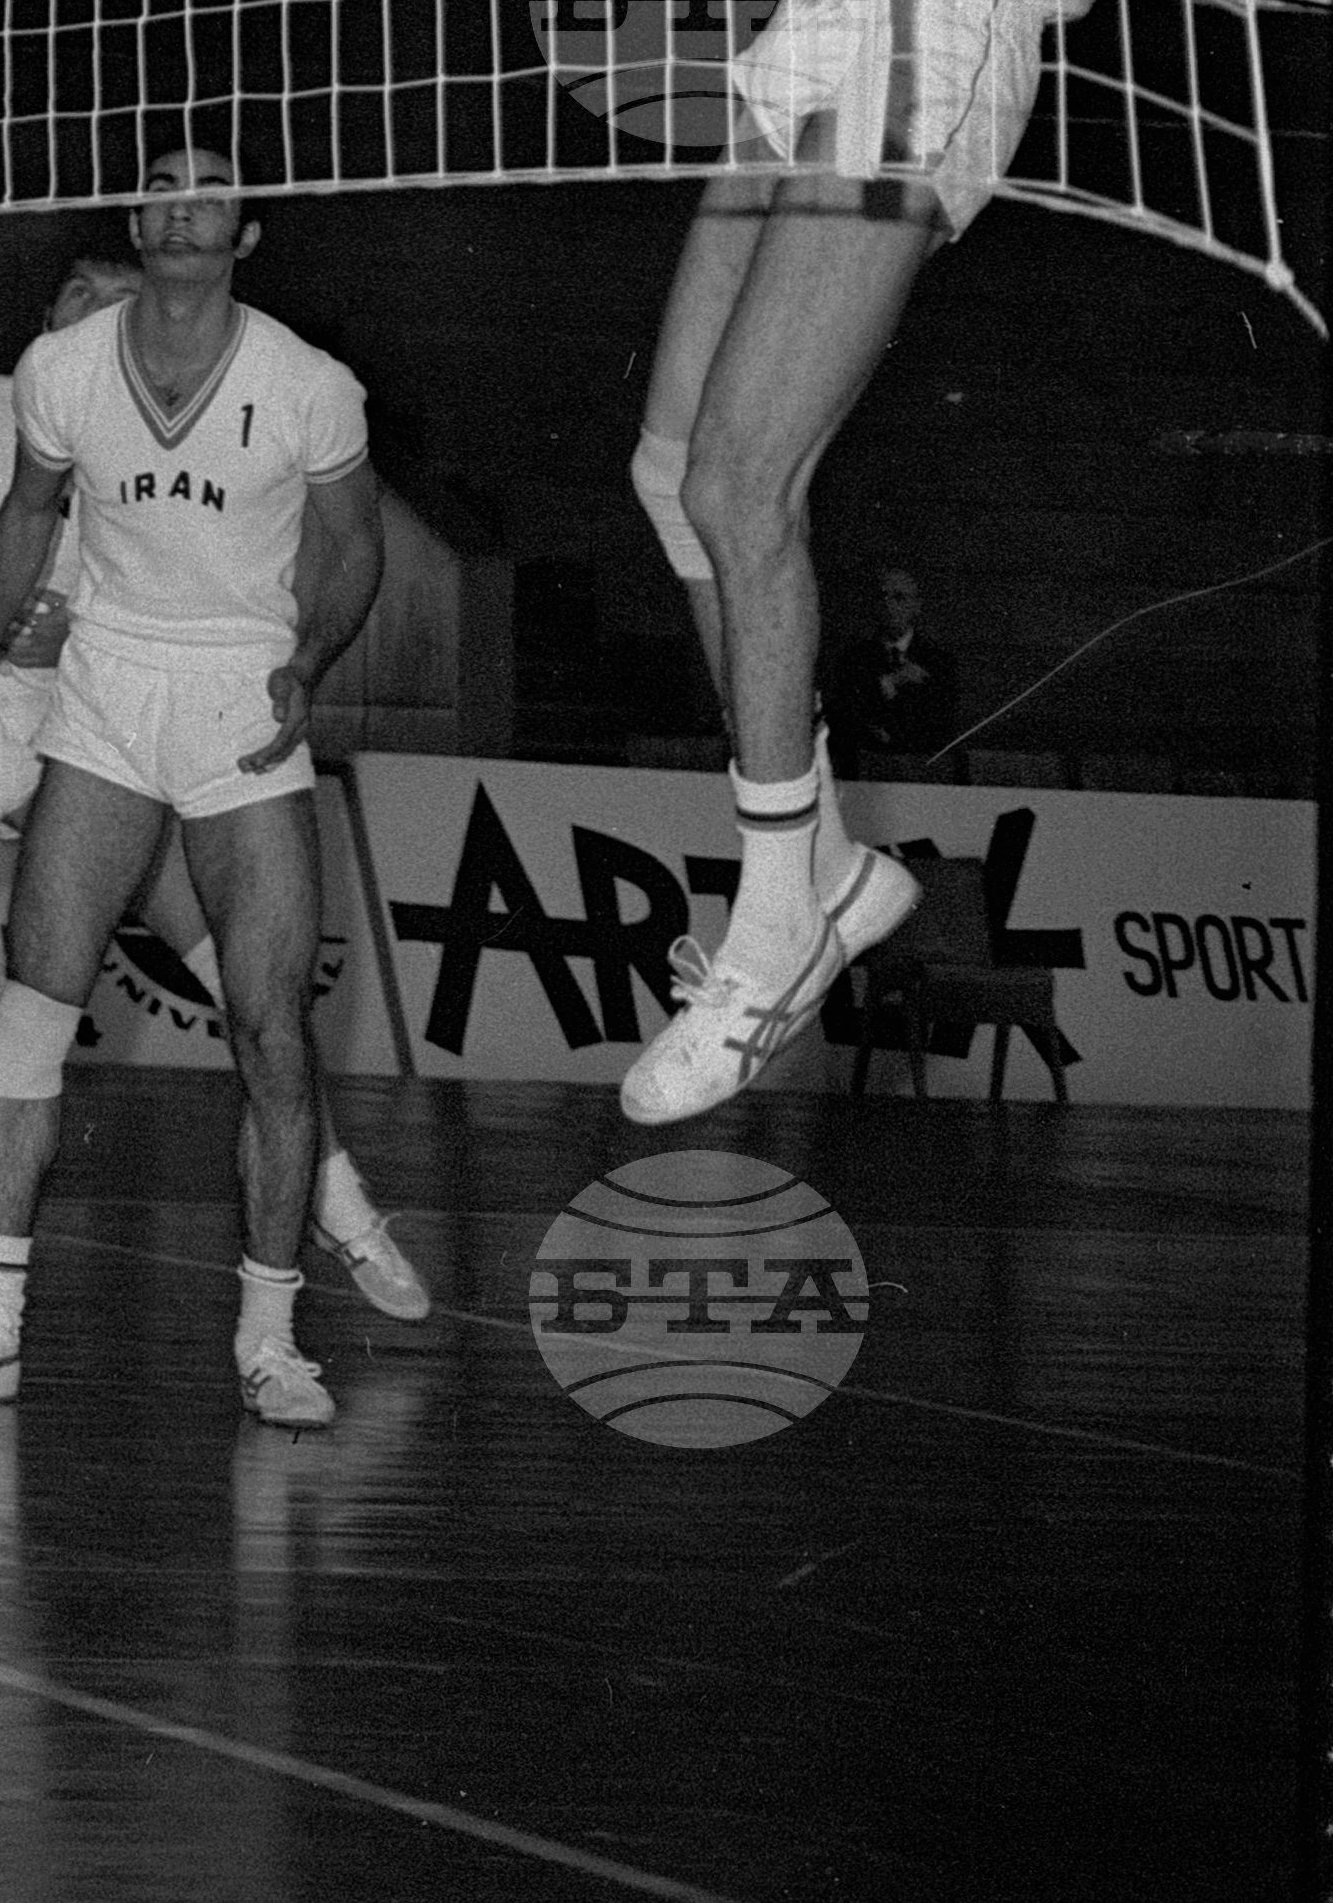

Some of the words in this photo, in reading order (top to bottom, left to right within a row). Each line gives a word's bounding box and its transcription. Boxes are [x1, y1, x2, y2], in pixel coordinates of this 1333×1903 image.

[241, 403, 254, 448] 1
[119, 471, 225, 513] IRAN
[1114, 910, 1310, 1003] SPORT
